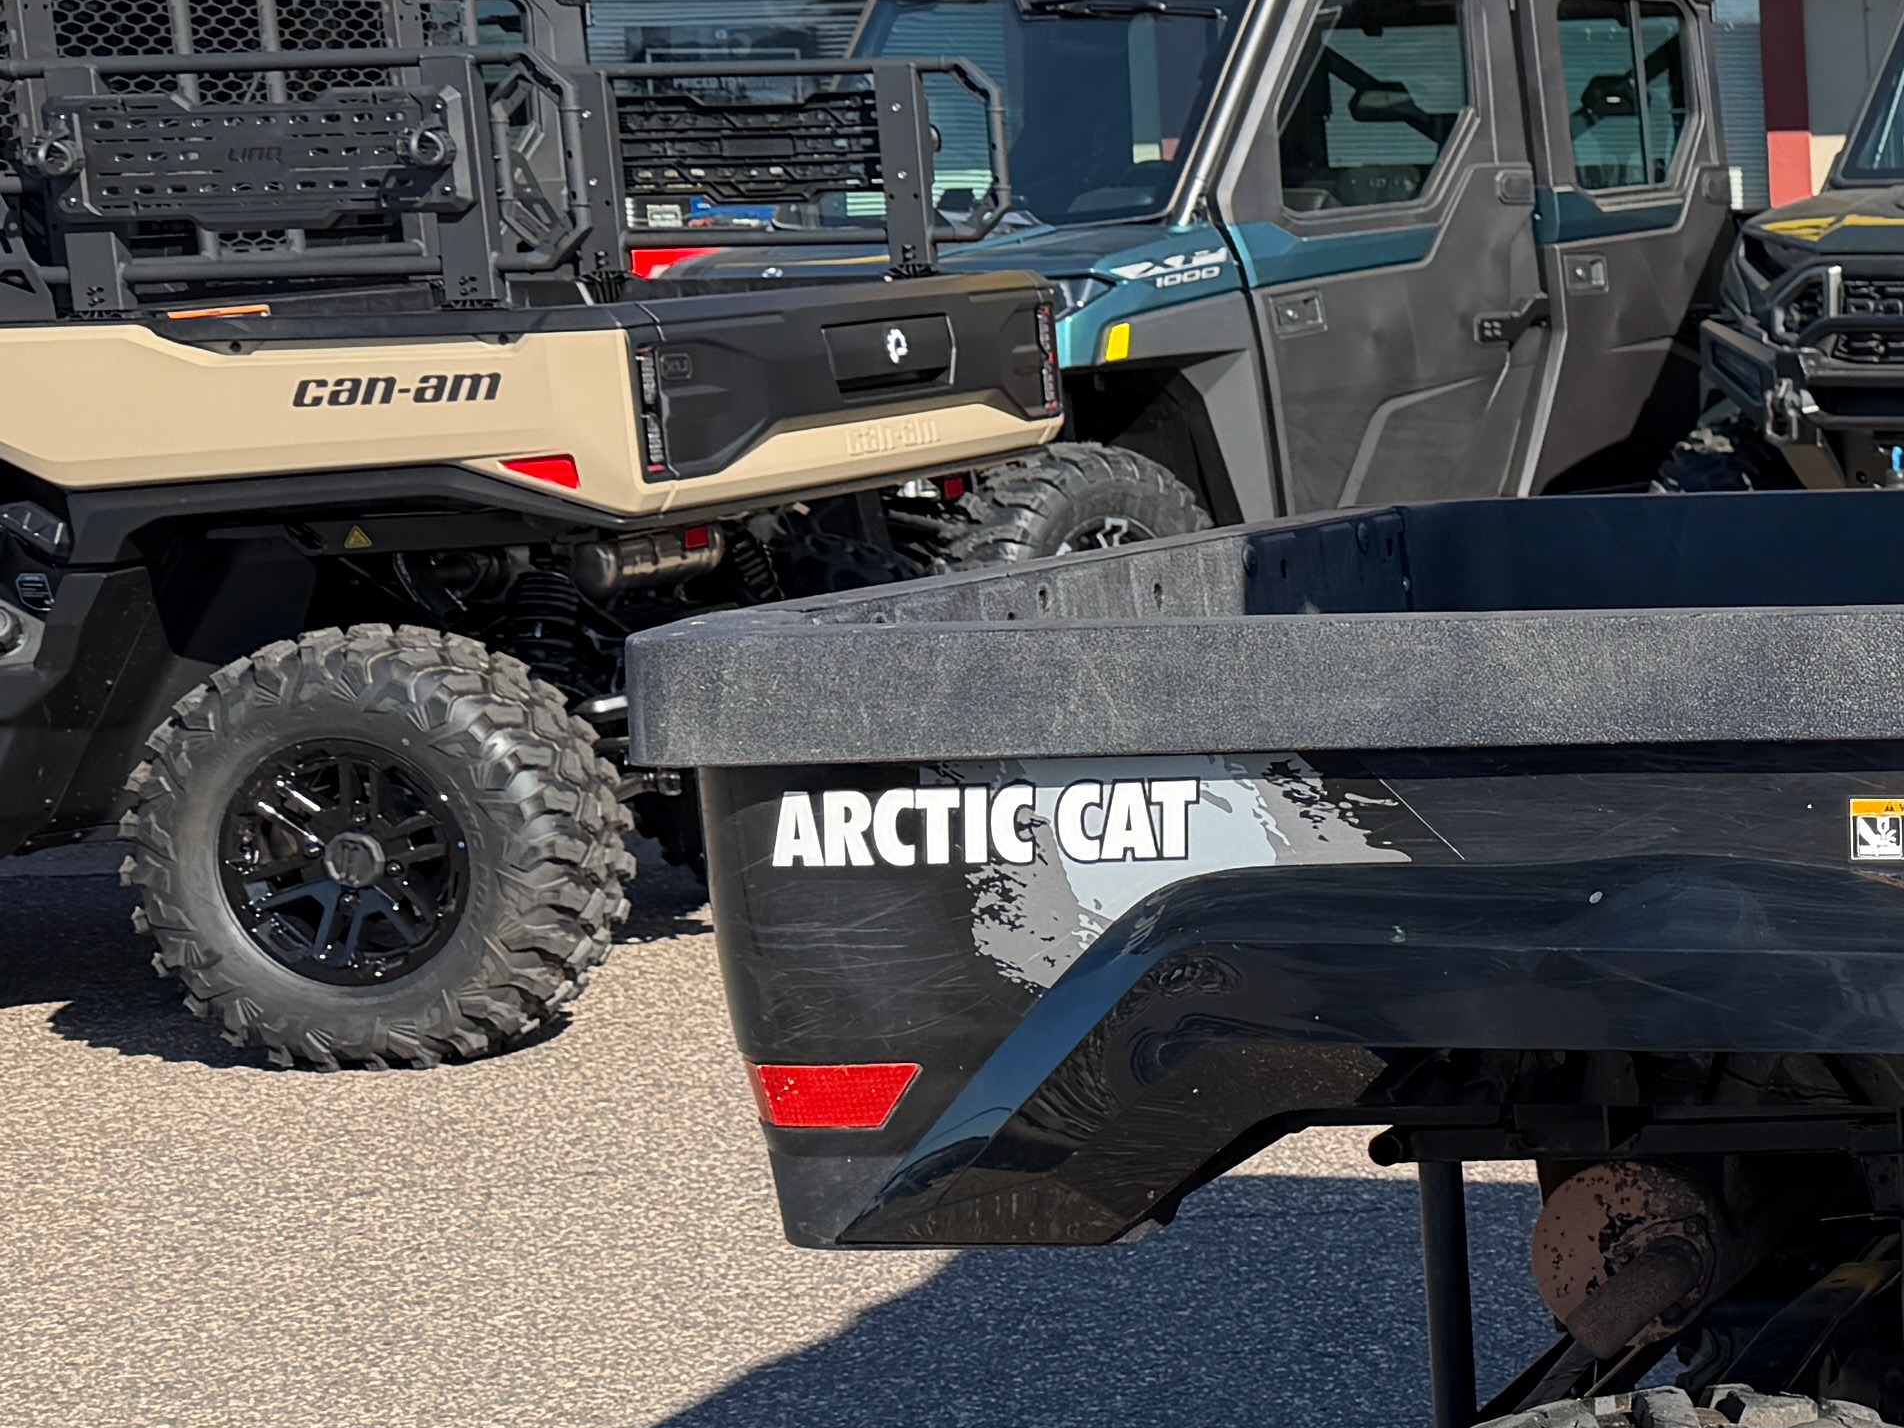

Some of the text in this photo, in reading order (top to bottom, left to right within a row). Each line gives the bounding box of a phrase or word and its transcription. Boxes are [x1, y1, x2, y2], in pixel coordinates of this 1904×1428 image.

[1156, 266, 1221, 288] 1000
[292, 372, 502, 408] can-am
[772, 777, 1200, 868] ARCTIC CAT
